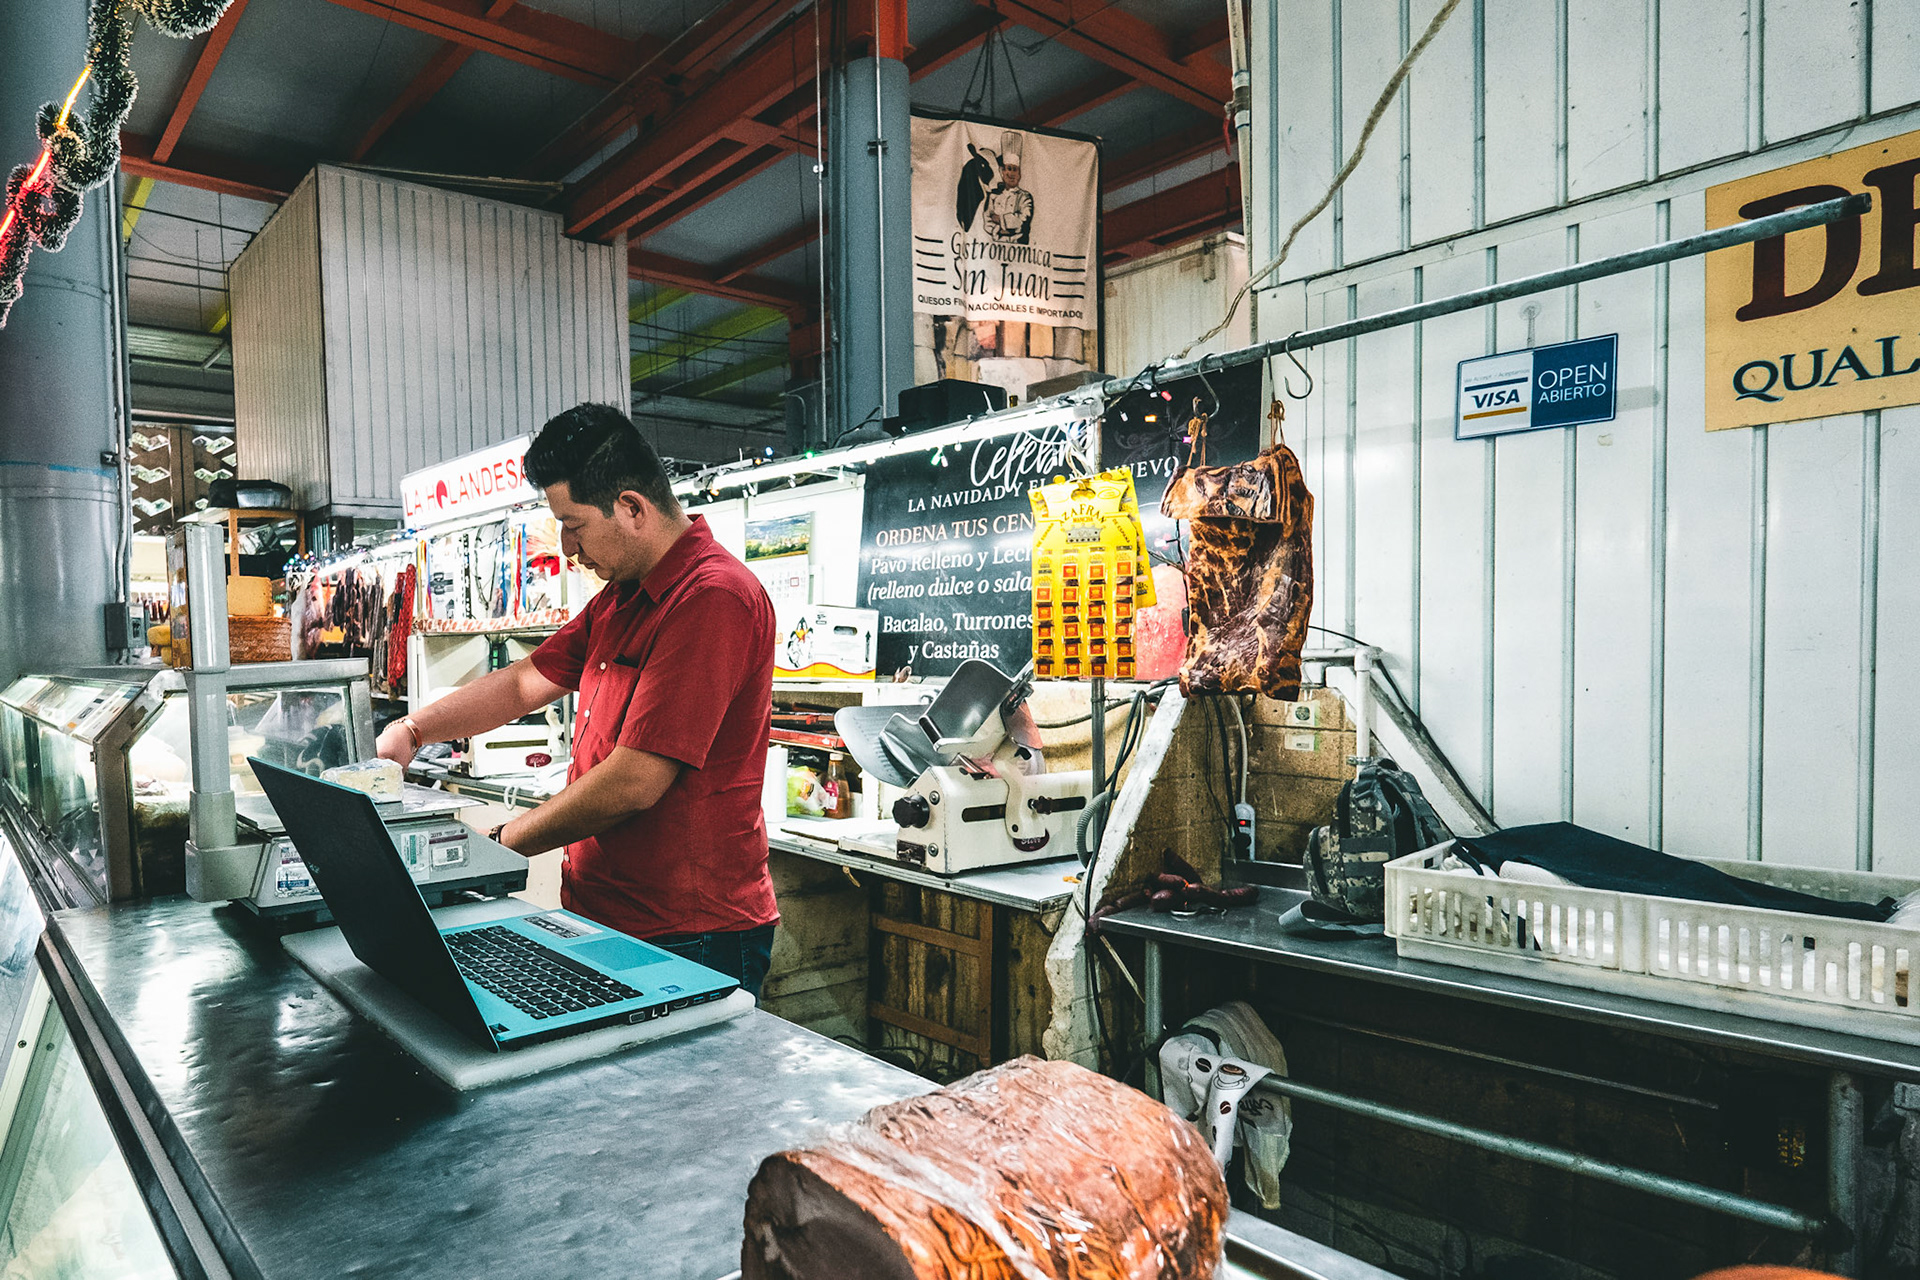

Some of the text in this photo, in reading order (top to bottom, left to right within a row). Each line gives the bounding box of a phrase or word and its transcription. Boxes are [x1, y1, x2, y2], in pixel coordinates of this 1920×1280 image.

[951, 231, 1051, 268] Gstronomica
[952, 256, 1050, 301] Sn Juan
[917, 294, 951, 306] QUESOS
[968, 302, 1027, 313] NACIONALES
[1036, 307, 1083, 320] IMPORTADO
[1538, 362, 1607, 389] OPEN
[1732, 332, 1920, 403] QUAL
[1471, 389, 1520, 409] VISA
[1538, 383, 1607, 404] ABIERTO
[405, 489, 423, 517] LA
[908, 499, 926, 513] LA
[931, 485, 1006, 510] NAVIDAD
[1013, 482, 1024, 497] Y
[876, 512, 1035, 548] ORDENA TUS CEN
[870, 558, 907, 575] Pavo
[911, 549, 973, 572] Relleno
[976, 551, 989, 572] y
[867, 579, 924, 606] (relleno
[928, 576, 973, 598] dulce
[978, 578, 989, 594] o
[993, 571, 1033, 593] sala
[883, 612, 948, 635] Bacalao,
[908, 640, 999, 664] y Castañas
